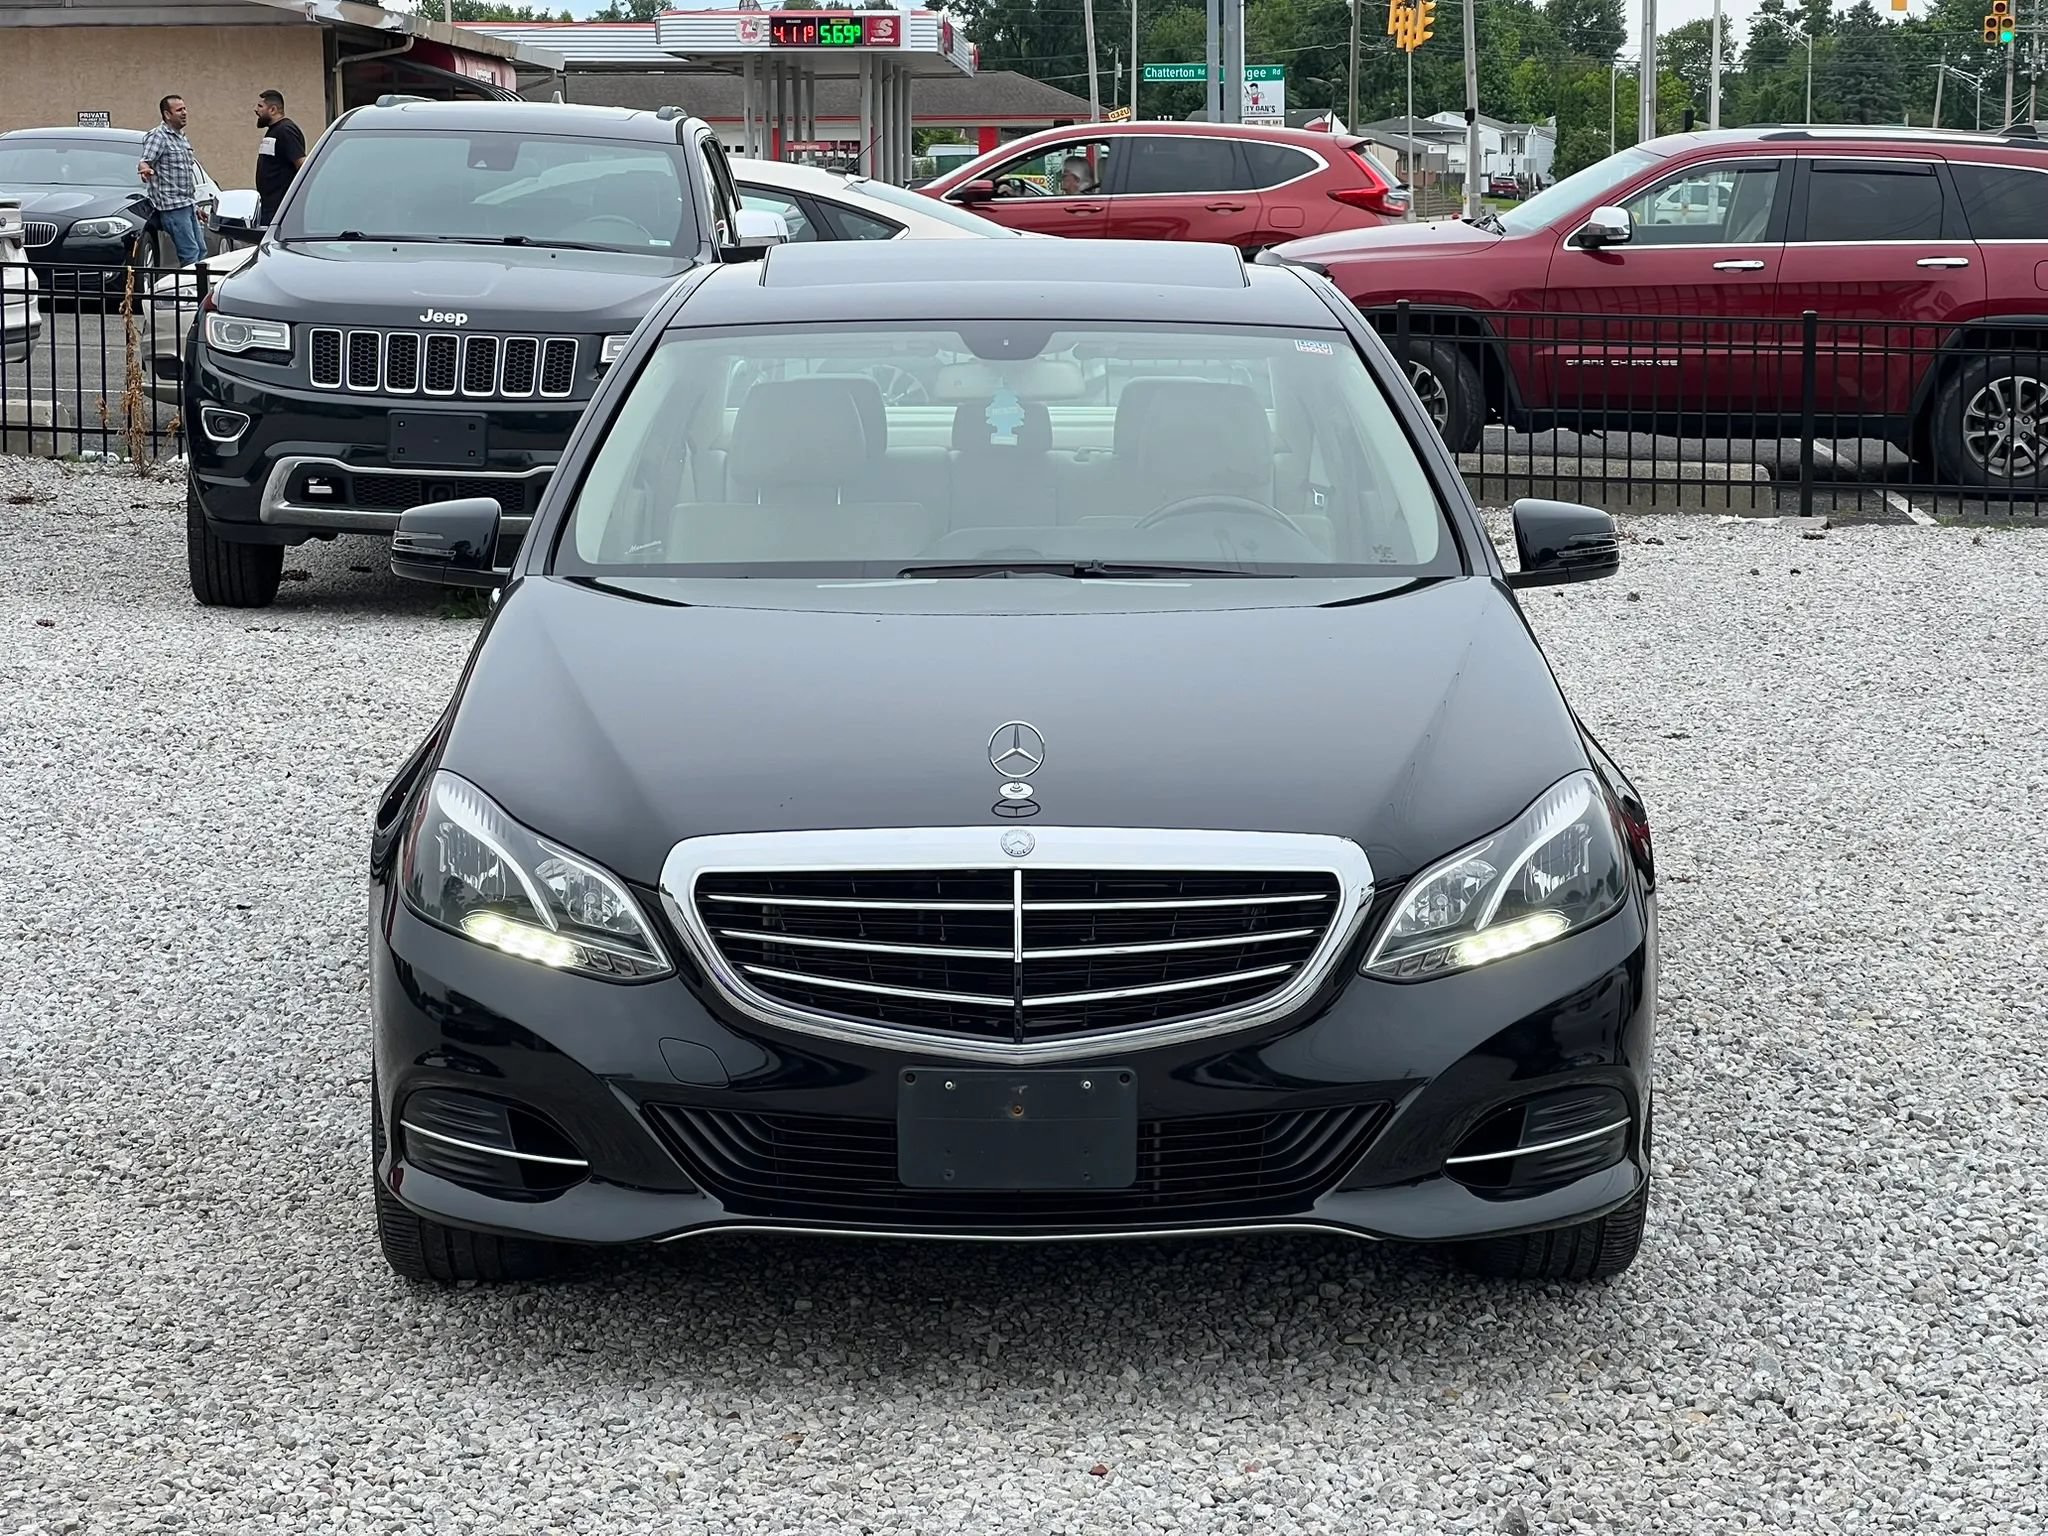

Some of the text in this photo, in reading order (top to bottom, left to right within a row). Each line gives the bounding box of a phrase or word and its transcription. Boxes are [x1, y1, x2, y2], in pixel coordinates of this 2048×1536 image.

[1145, 67, 1206, 78] Chatterton Rd
[1272, 68, 1281, 76] Rd
[419, 308, 468, 327] Jeep
